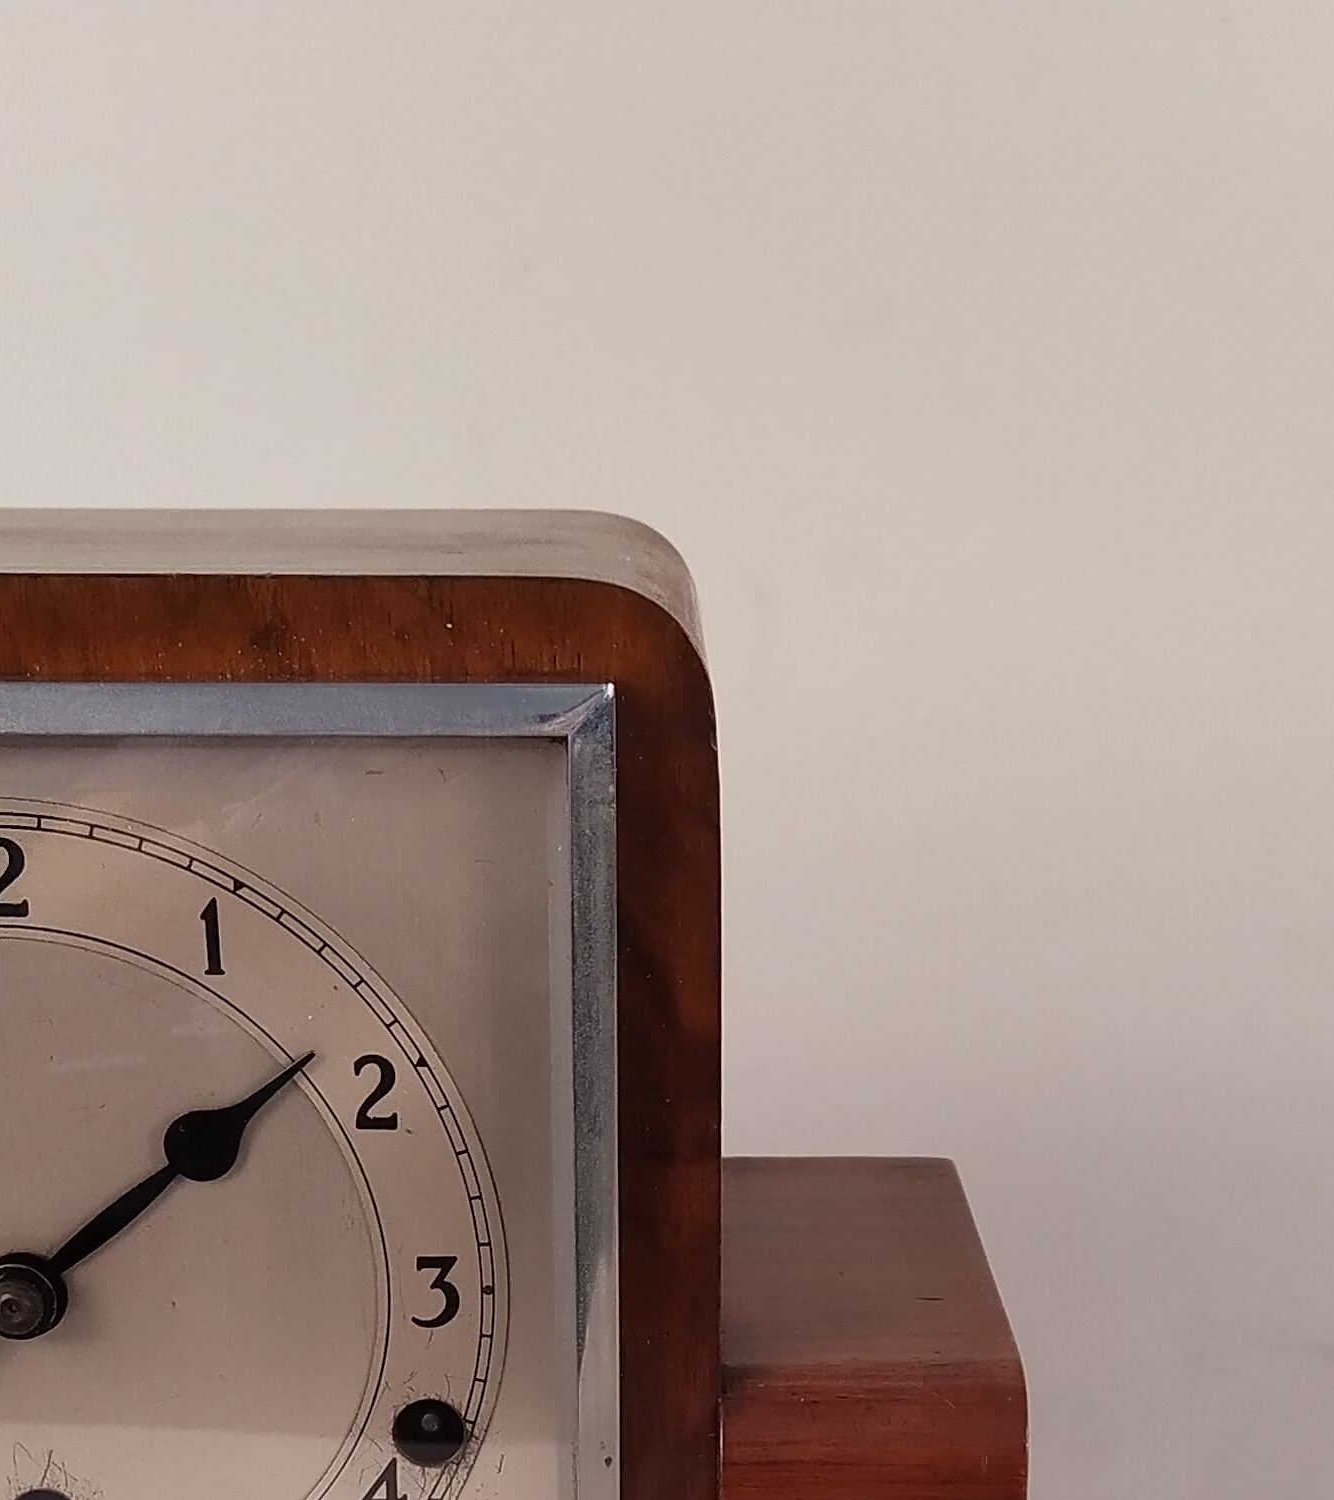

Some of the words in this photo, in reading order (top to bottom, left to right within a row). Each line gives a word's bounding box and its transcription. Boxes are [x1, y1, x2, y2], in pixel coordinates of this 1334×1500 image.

[200, 897, 225, 975] 1
[354, 1055, 399, 1130] 2
[412, 1256, 460, 1329] 3
